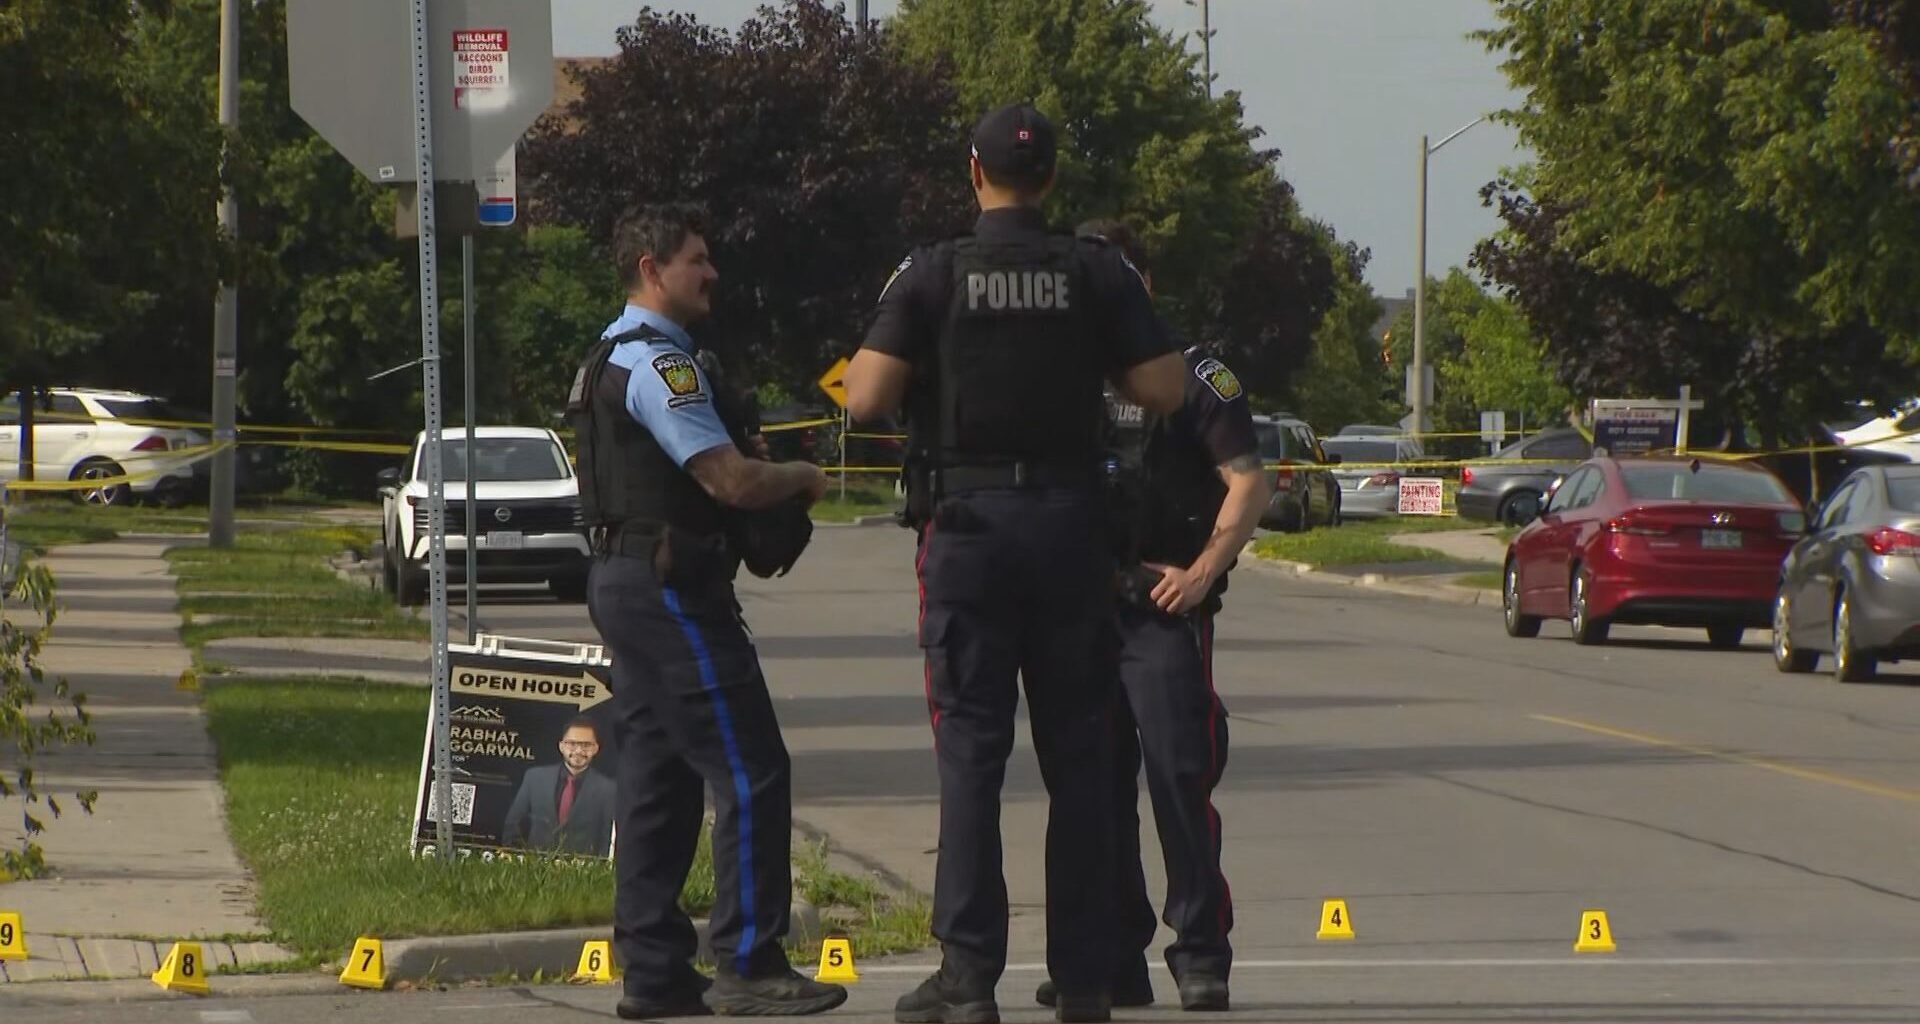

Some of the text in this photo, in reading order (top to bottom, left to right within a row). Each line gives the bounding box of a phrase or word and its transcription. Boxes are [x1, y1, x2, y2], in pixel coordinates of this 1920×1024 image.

[457, 33, 503, 42] WILDLIFE
[458, 53, 503, 62] RACCOONS
[468, 65, 493, 74] BIRDS
[967, 271, 1070, 310] POLICE
[1401, 485, 1440, 498] PAINTING
[458, 672, 596, 698] OPEN HOUSE
[450, 725, 520, 745] RABHAT
[450, 741, 535, 760] GGARWAL
[1331, 907, 1342, 927] 4
[0, 923, 13, 946] 9
[1590, 919, 1601, 940] 3
[182, 953, 195, 977] 8
[362, 949, 375, 972] 7
[588, 949, 601, 972] 6
[828, 948, 843, 967] 5
